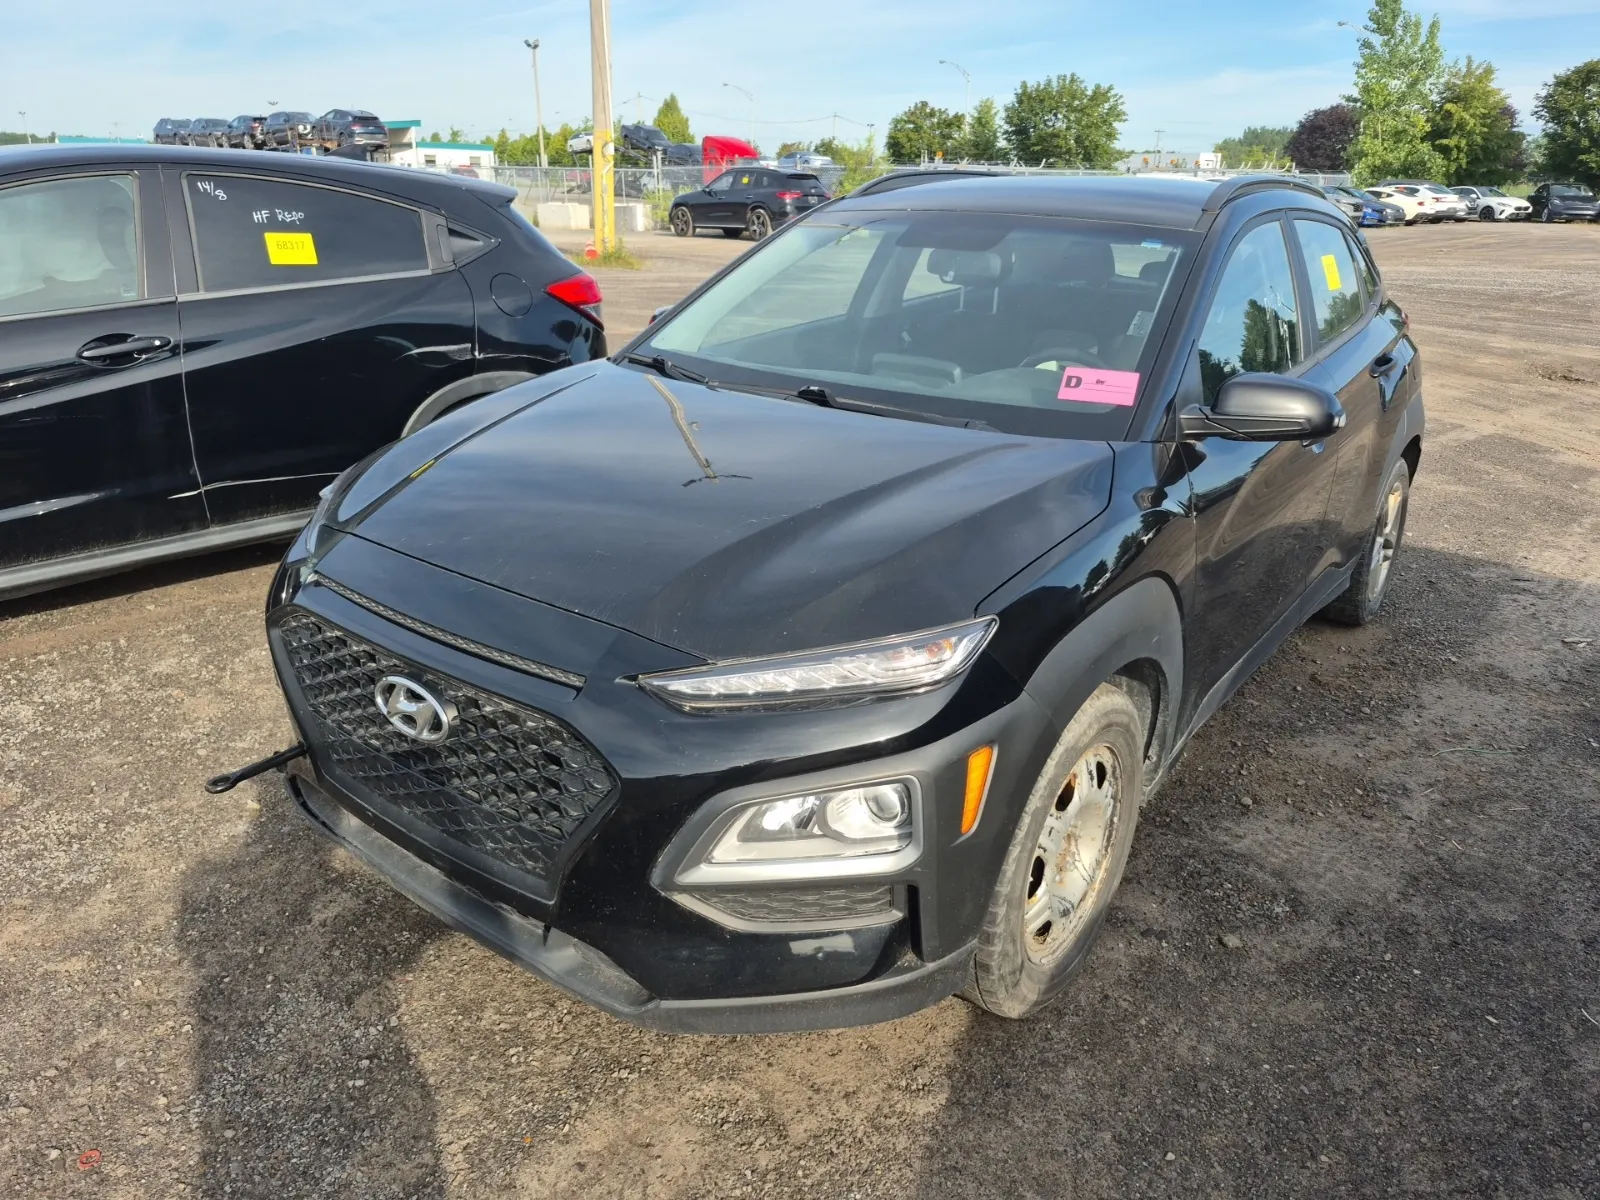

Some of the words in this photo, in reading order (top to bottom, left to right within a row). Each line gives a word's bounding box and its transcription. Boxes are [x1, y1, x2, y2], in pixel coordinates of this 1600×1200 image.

[197, 181, 227, 201] 14/8
[253, 210, 270, 223] HF
[276, 240, 305, 251] 68317
[1064, 375, 1082, 388] D
